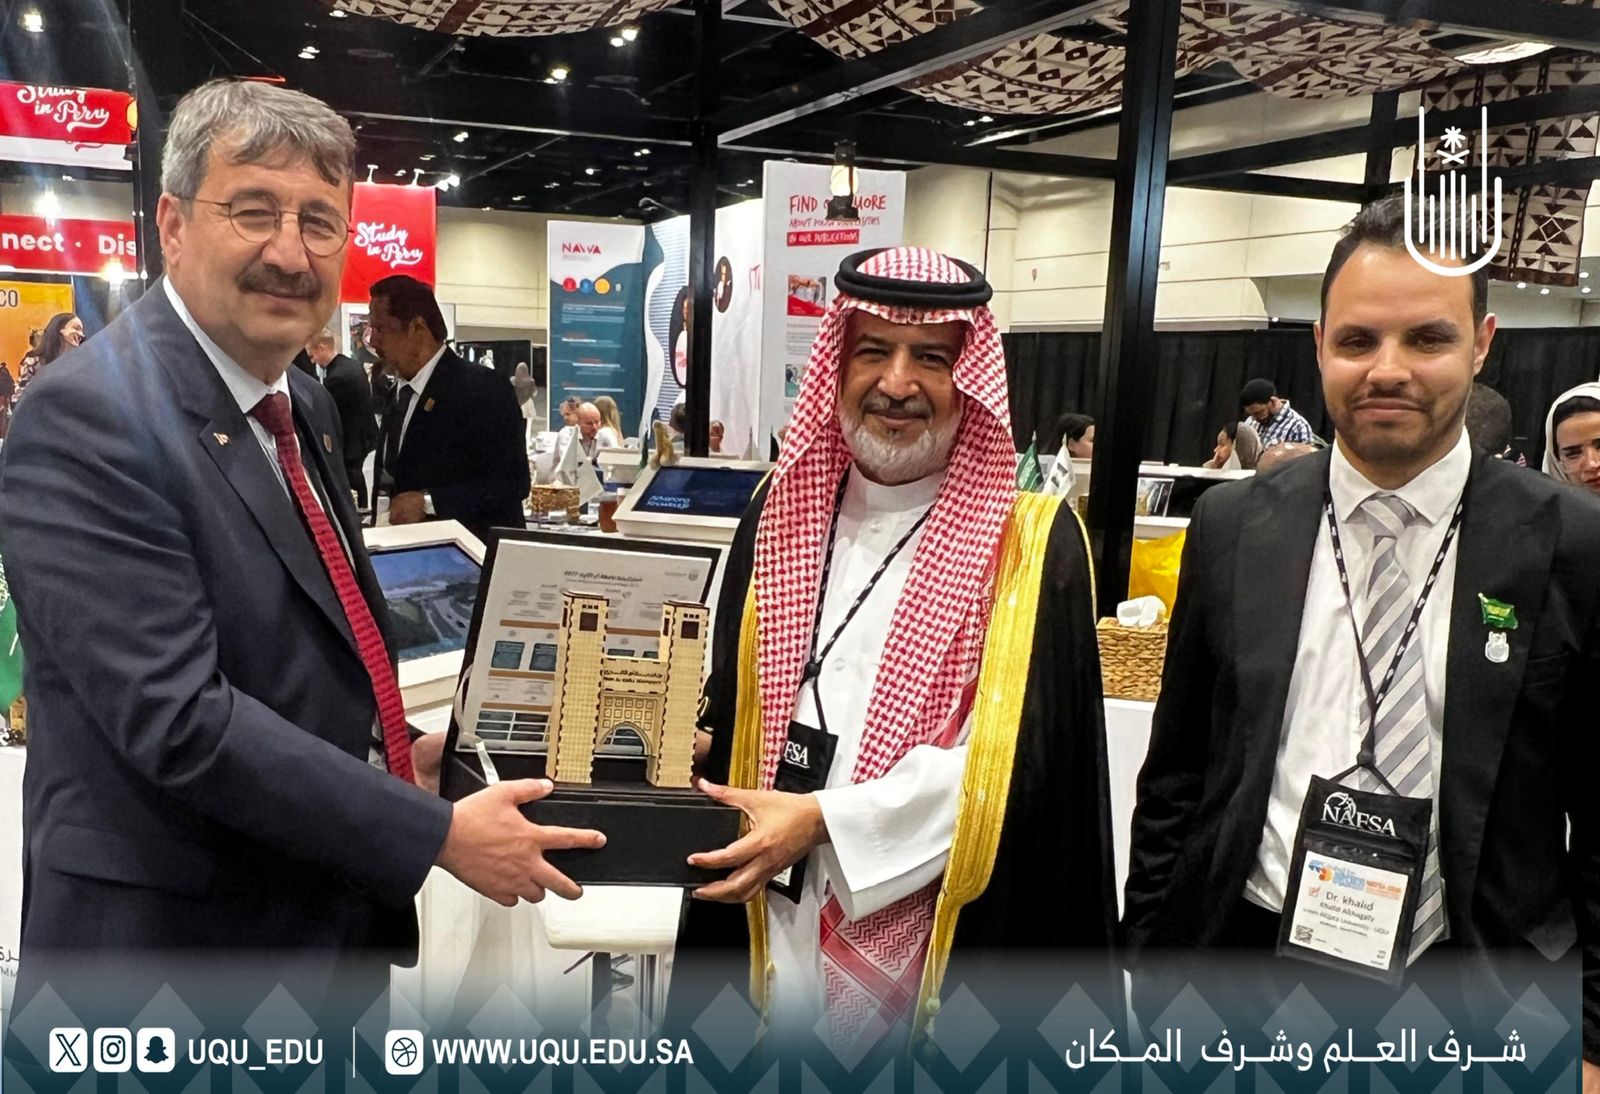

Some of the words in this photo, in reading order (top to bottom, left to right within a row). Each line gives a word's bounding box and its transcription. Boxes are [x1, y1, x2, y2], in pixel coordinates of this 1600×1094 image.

[34, 100, 53, 115] in
[53, 99, 110, 133] Peru
[789, 194, 818, 214] FIND
[1, 231, 65, 252] nect
[97, 233, 137, 257] Dis
[353, 221, 409, 247] Study
[381, 242, 424, 269] Peru
[1320, 802, 1397, 837] NAFSA
